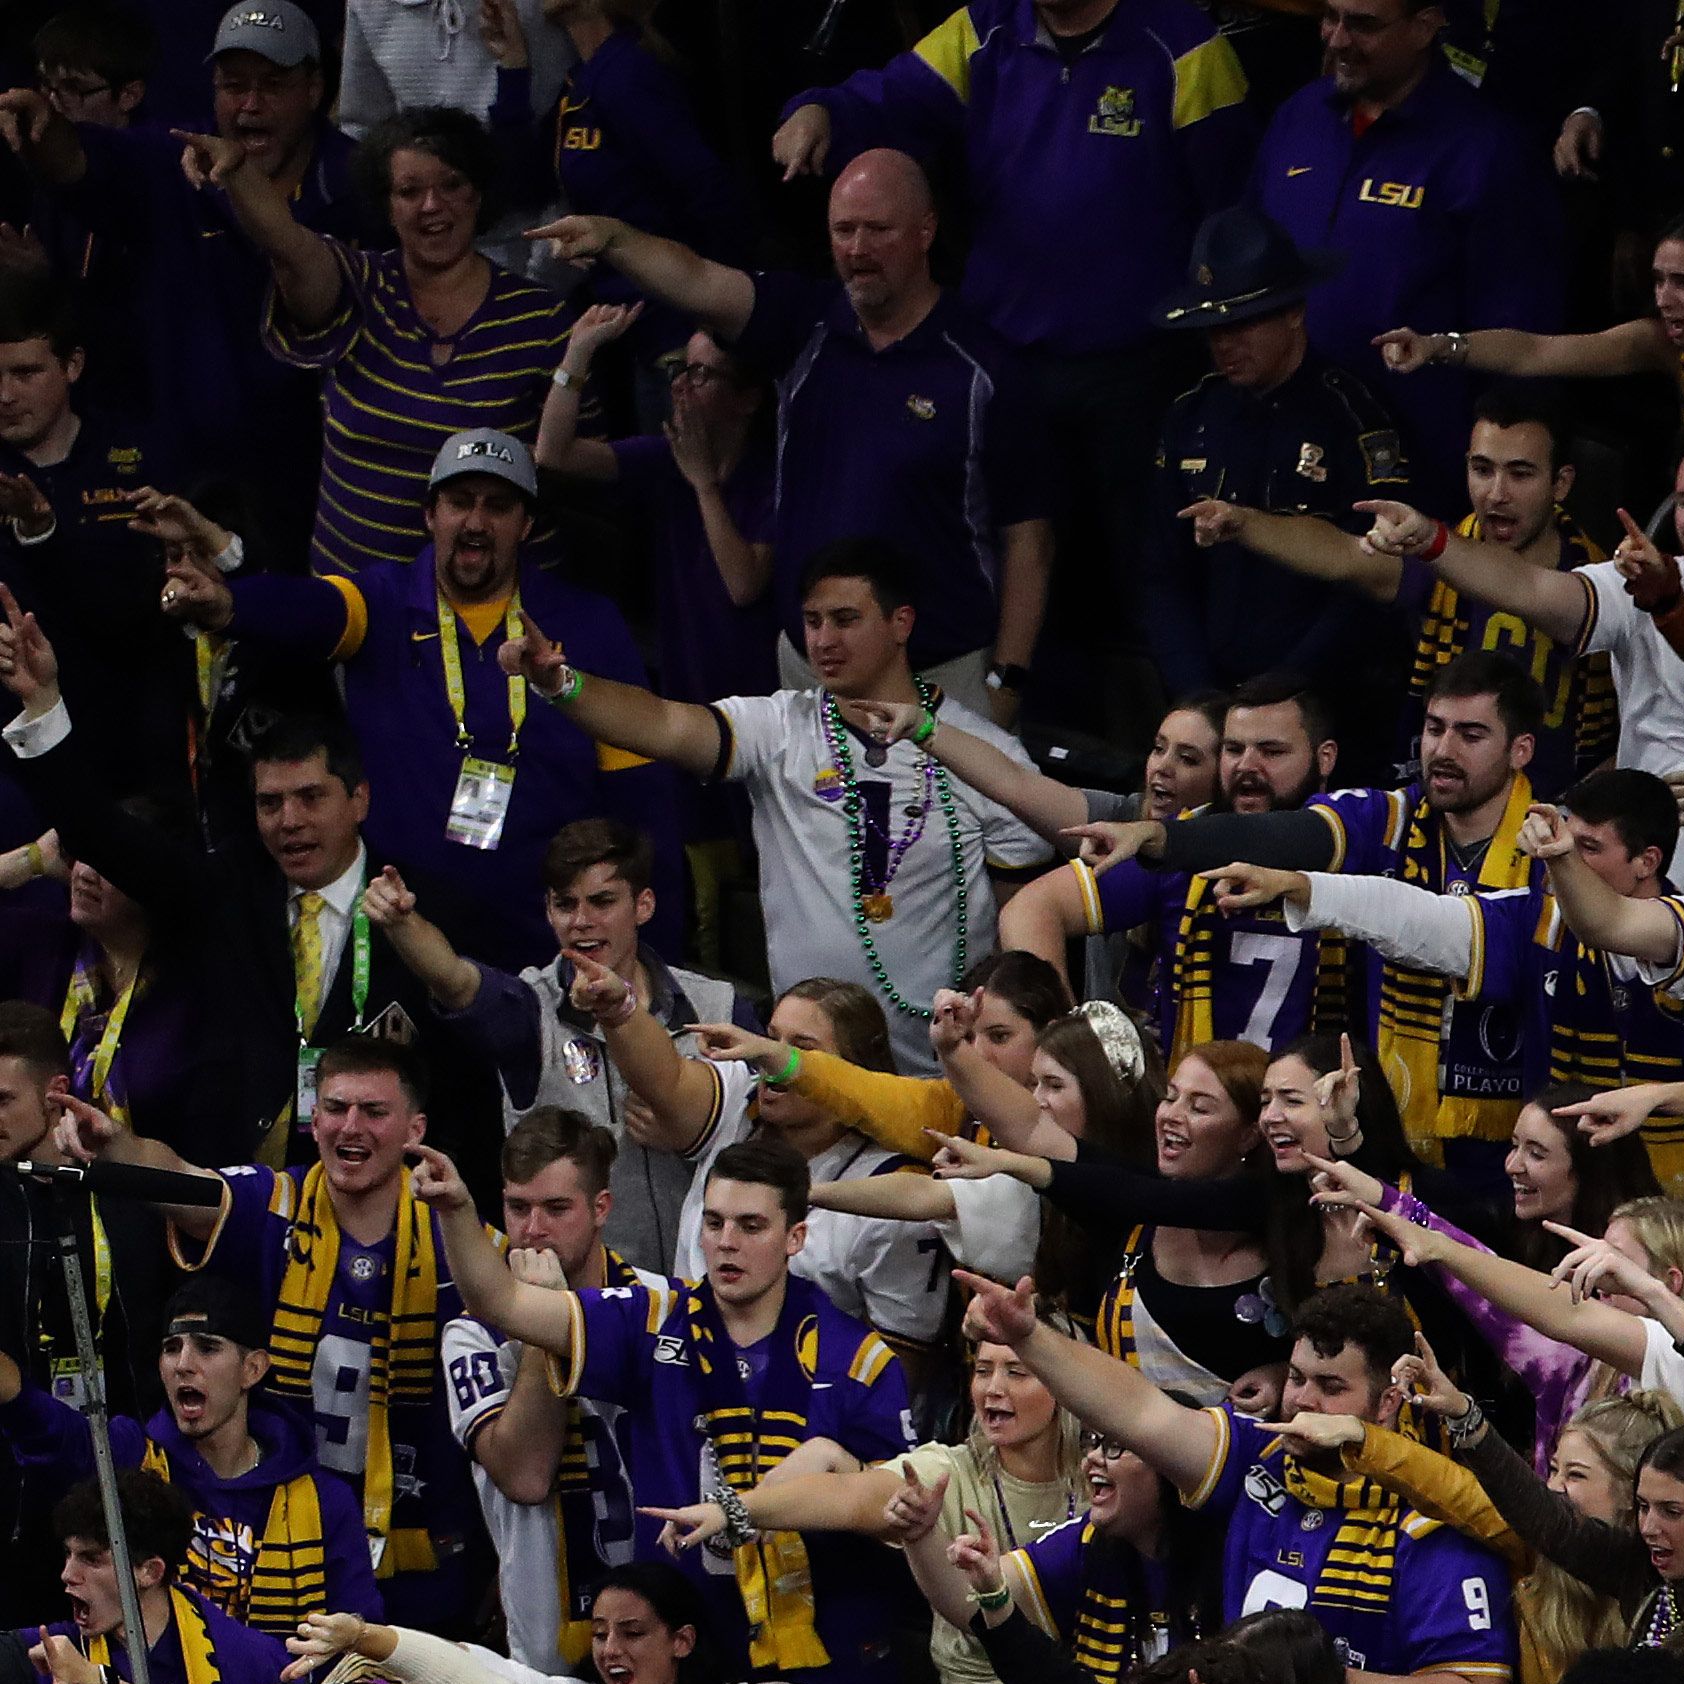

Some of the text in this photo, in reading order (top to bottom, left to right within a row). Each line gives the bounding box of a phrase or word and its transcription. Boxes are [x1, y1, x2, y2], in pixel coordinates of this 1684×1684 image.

[1087, 115, 1144, 136] LSU
[564, 128, 600, 149] SU
[1359, 179, 1424, 208] LSU
[1231, 932, 1302, 1052] 7
[1454, 1074, 1519, 1091] PLAYO
[1461, 1576, 1490, 1628] 9
